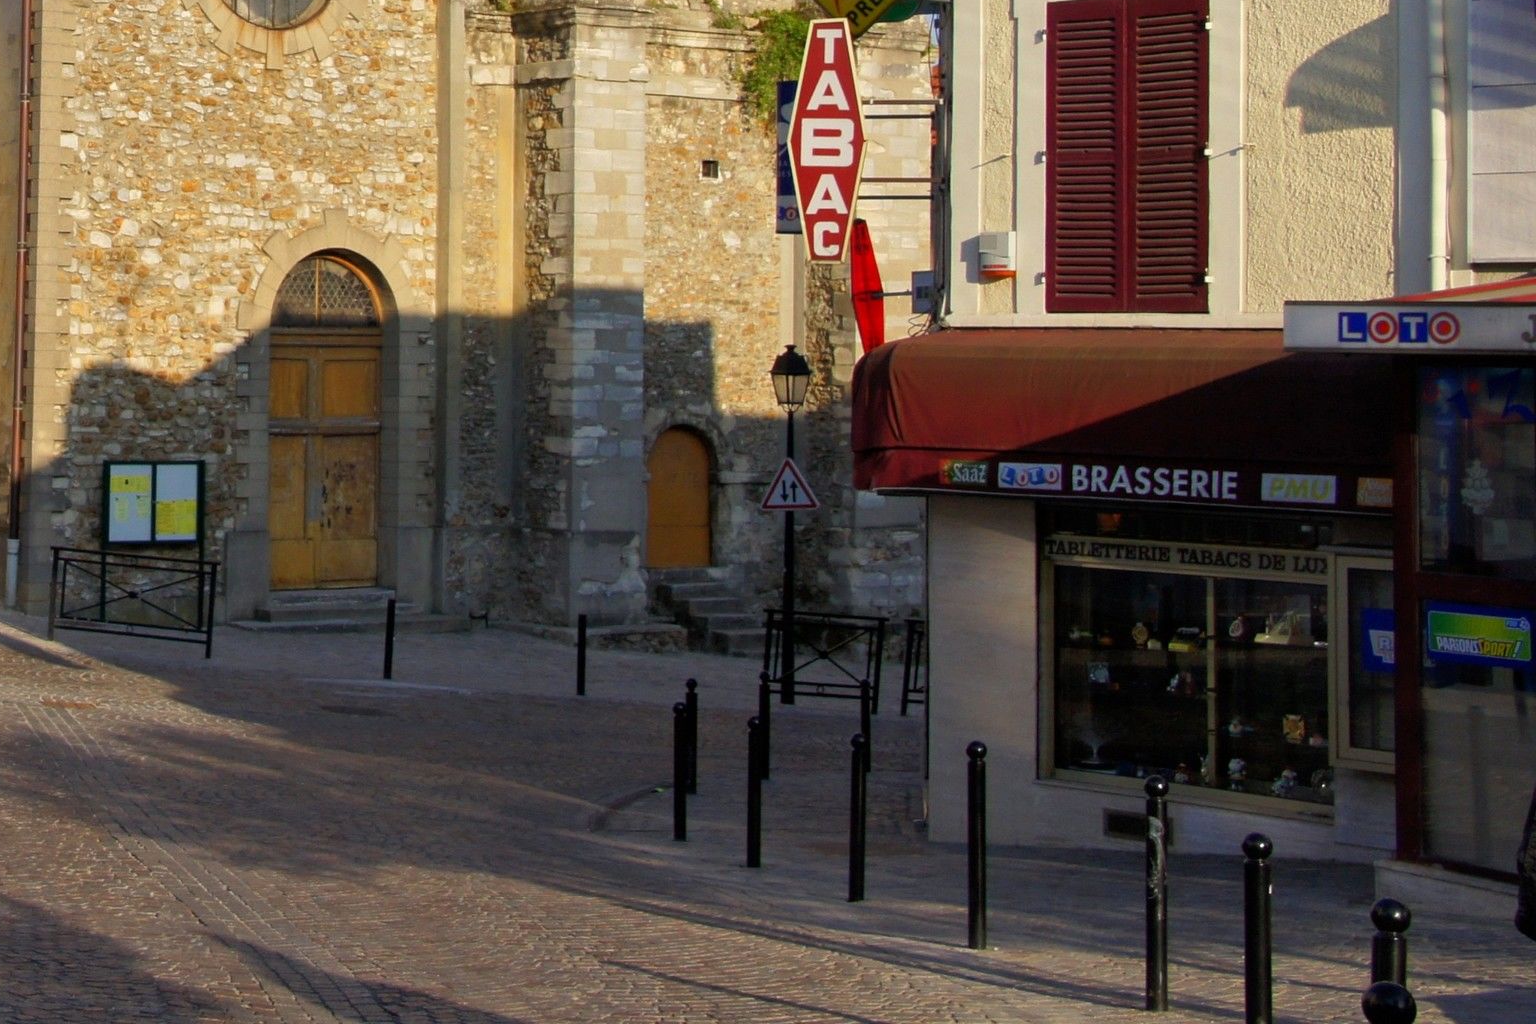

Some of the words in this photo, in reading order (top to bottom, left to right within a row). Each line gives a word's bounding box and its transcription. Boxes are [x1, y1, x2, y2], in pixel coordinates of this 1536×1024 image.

[800, 28, 855, 257] TABAC
[1338, 311, 1461, 345] LOTO
[1000, 465, 1060, 487] LOTO
[1072, 465, 1238, 500] BRASSERIE
[1270, 478, 1330, 500] PMU
[1045, 538, 1171, 563] TABLETTERIE
[1177, 547, 1252, 569] TABACS
[1258, 553, 1286, 571] DE
